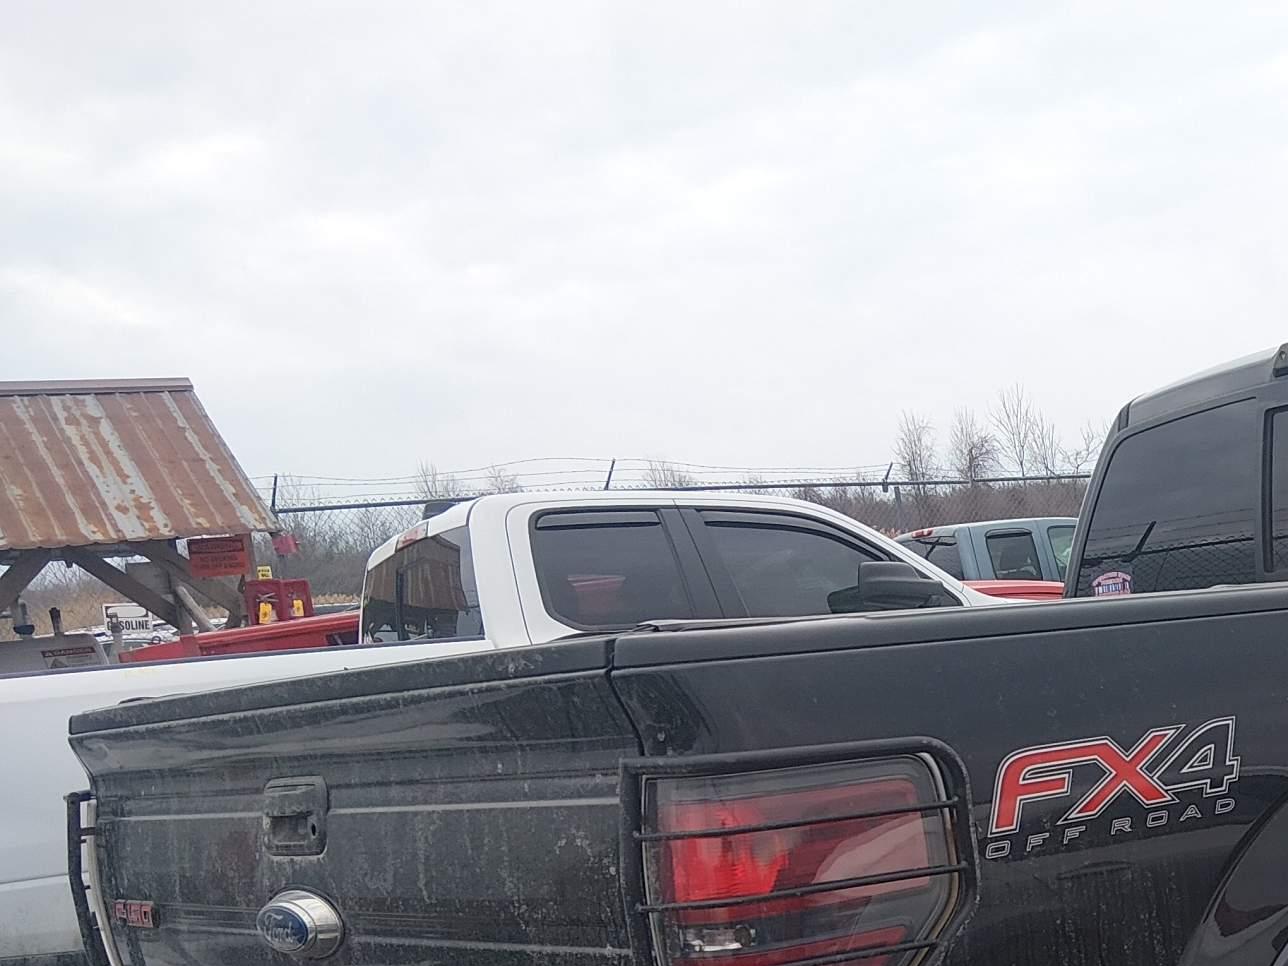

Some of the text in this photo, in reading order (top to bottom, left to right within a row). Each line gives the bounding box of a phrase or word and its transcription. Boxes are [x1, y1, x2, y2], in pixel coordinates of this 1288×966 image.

[107, 619, 151, 631] GSOLINE
[987, 715, 1241, 838] FX4
[985, 798, 1237, 860] OFF ROAD
[263, 912, 299, 944] Ford
